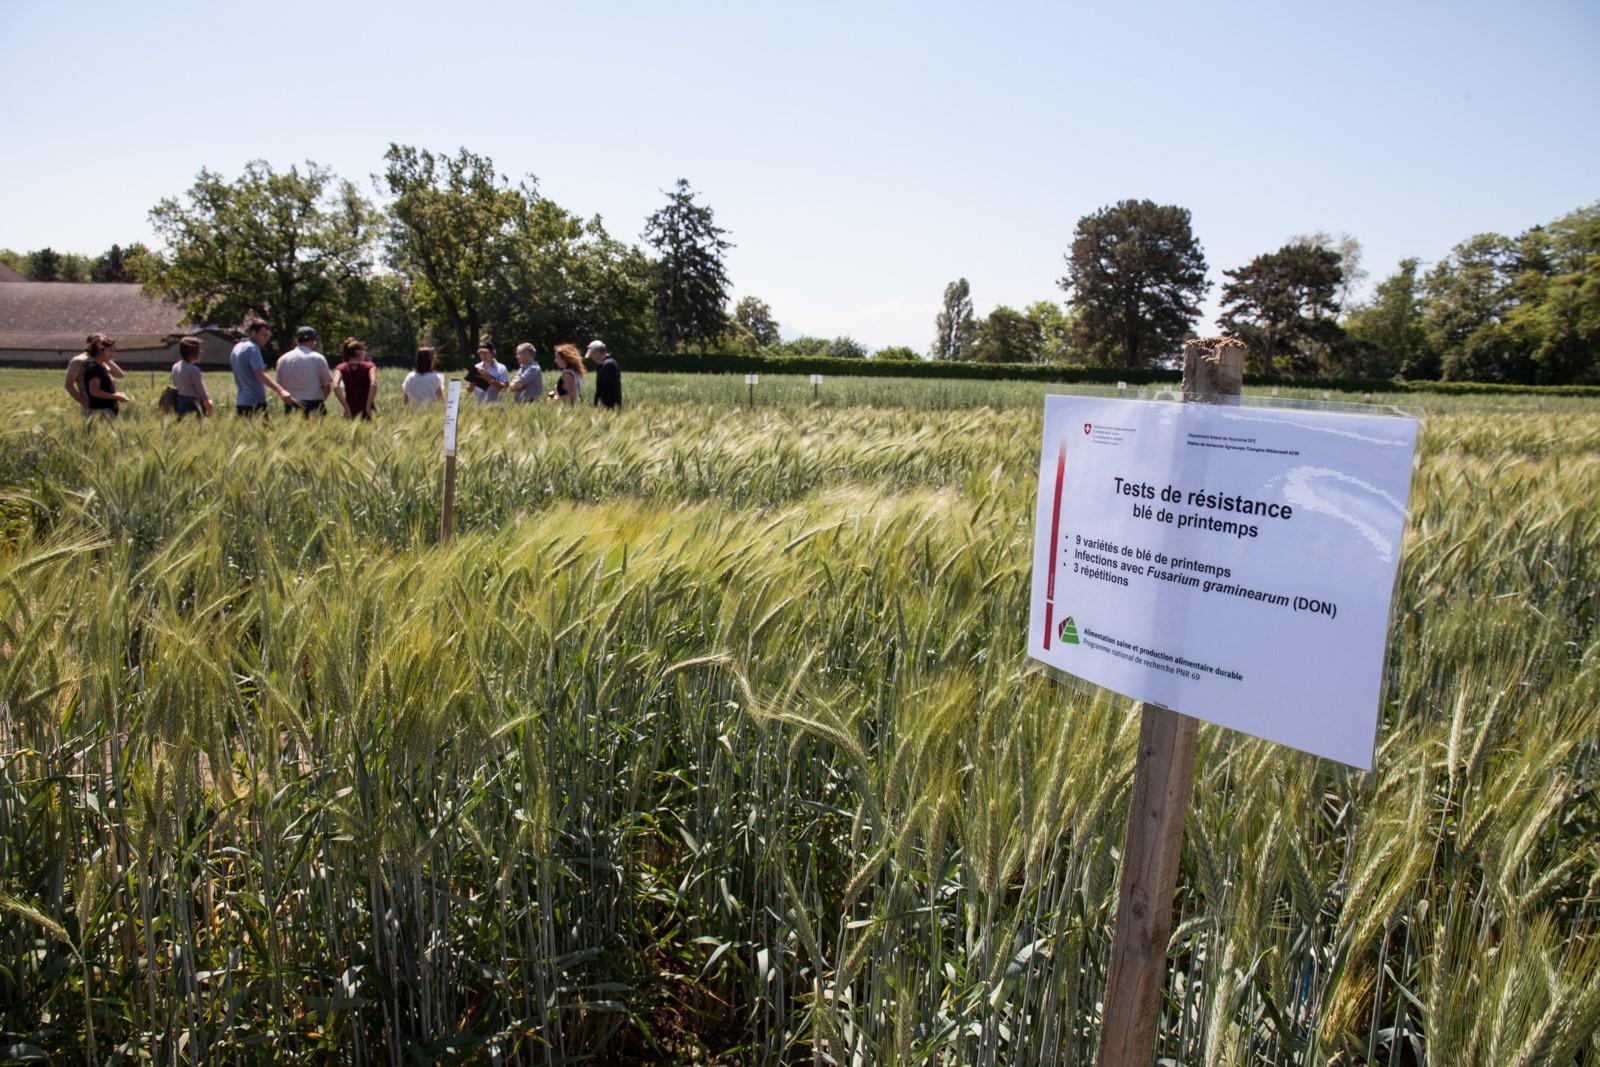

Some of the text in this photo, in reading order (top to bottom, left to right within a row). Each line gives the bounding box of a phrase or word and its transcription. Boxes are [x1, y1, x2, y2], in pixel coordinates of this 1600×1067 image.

[1114, 477, 1292, 519] Tests de résistance
[1133, 504, 1258, 538] blé de printemps
[1073, 562, 1129, 587] 3 répétitions
[1076, 534, 1231, 578] 9 variétés de blé de printemps
[1075, 548, 1337, 619] Infections avec Fusarium graminearum (DON)
[1083, 638, 1200, 681] Programme national de recherche PNR 69
[1084, 628, 1243, 681] Alimentation saine et production alimentaire durable
